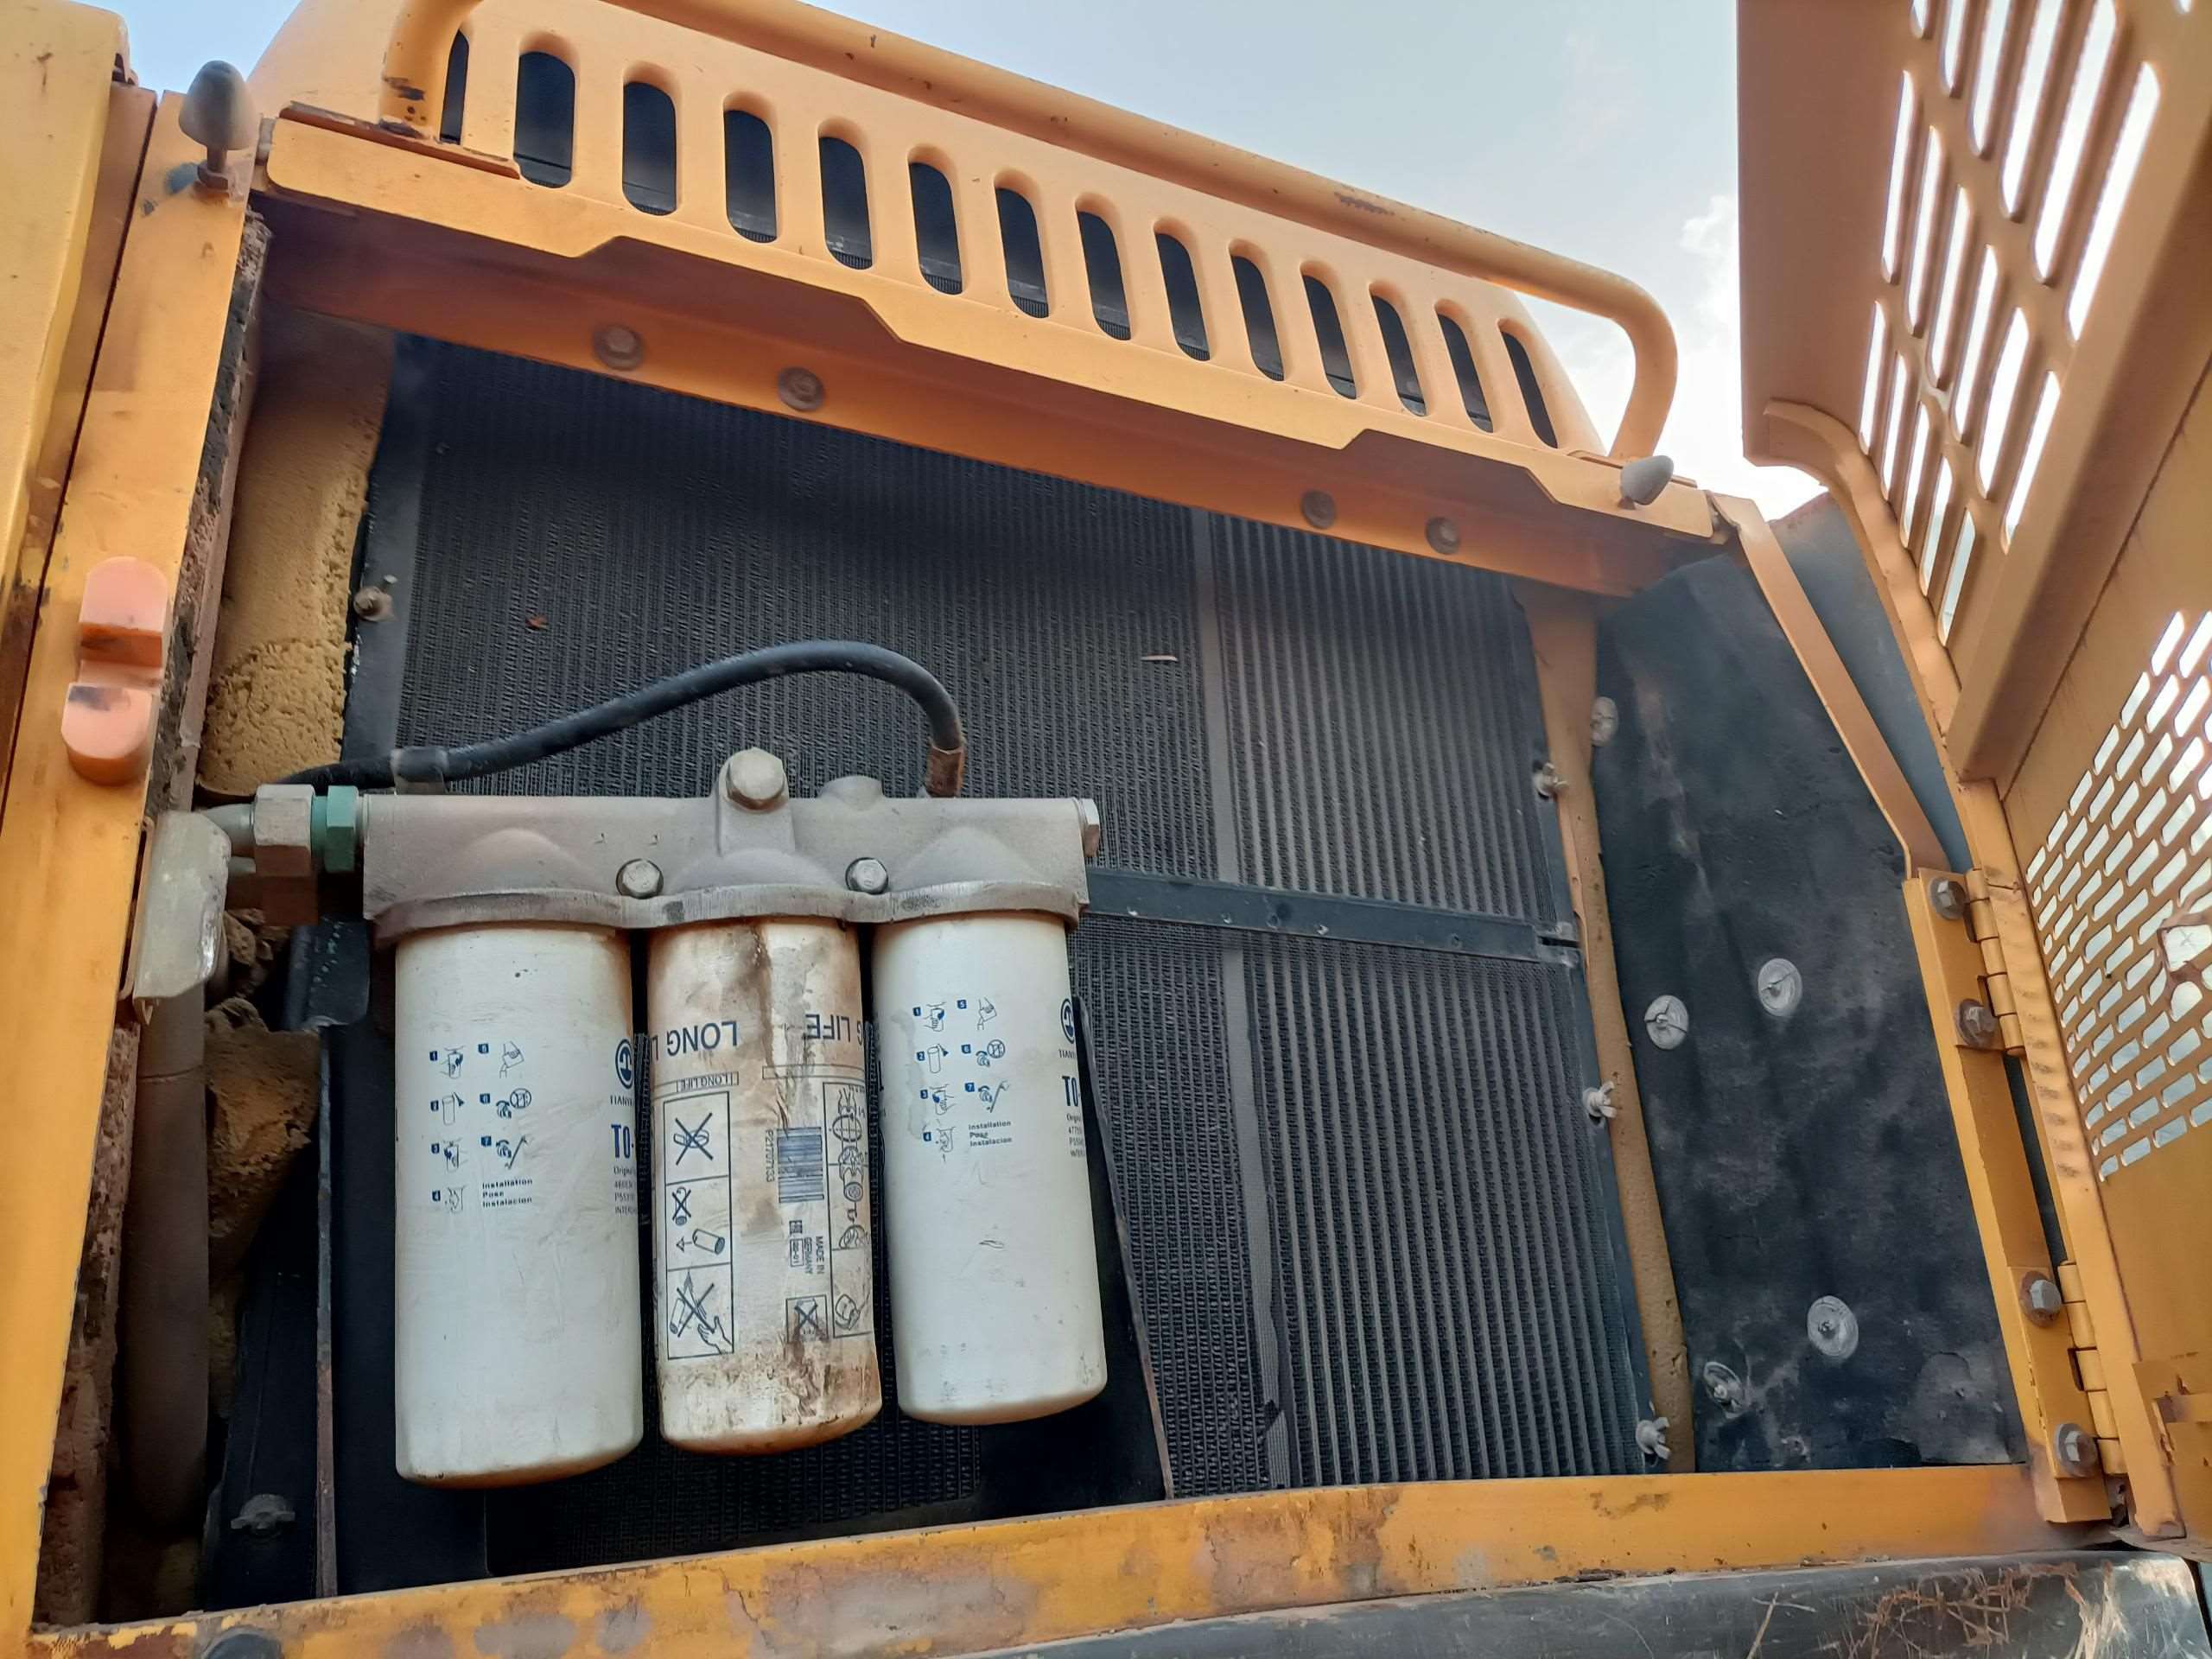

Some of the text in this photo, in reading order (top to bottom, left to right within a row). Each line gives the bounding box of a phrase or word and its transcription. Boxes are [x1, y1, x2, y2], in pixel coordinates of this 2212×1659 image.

[666, 1020, 738, 1056] LONG
[804, 1014, 851, 1043] LIFE
[968, 1121, 1012, 1130] Installation
[815, 1236, 825, 1262] MADE
